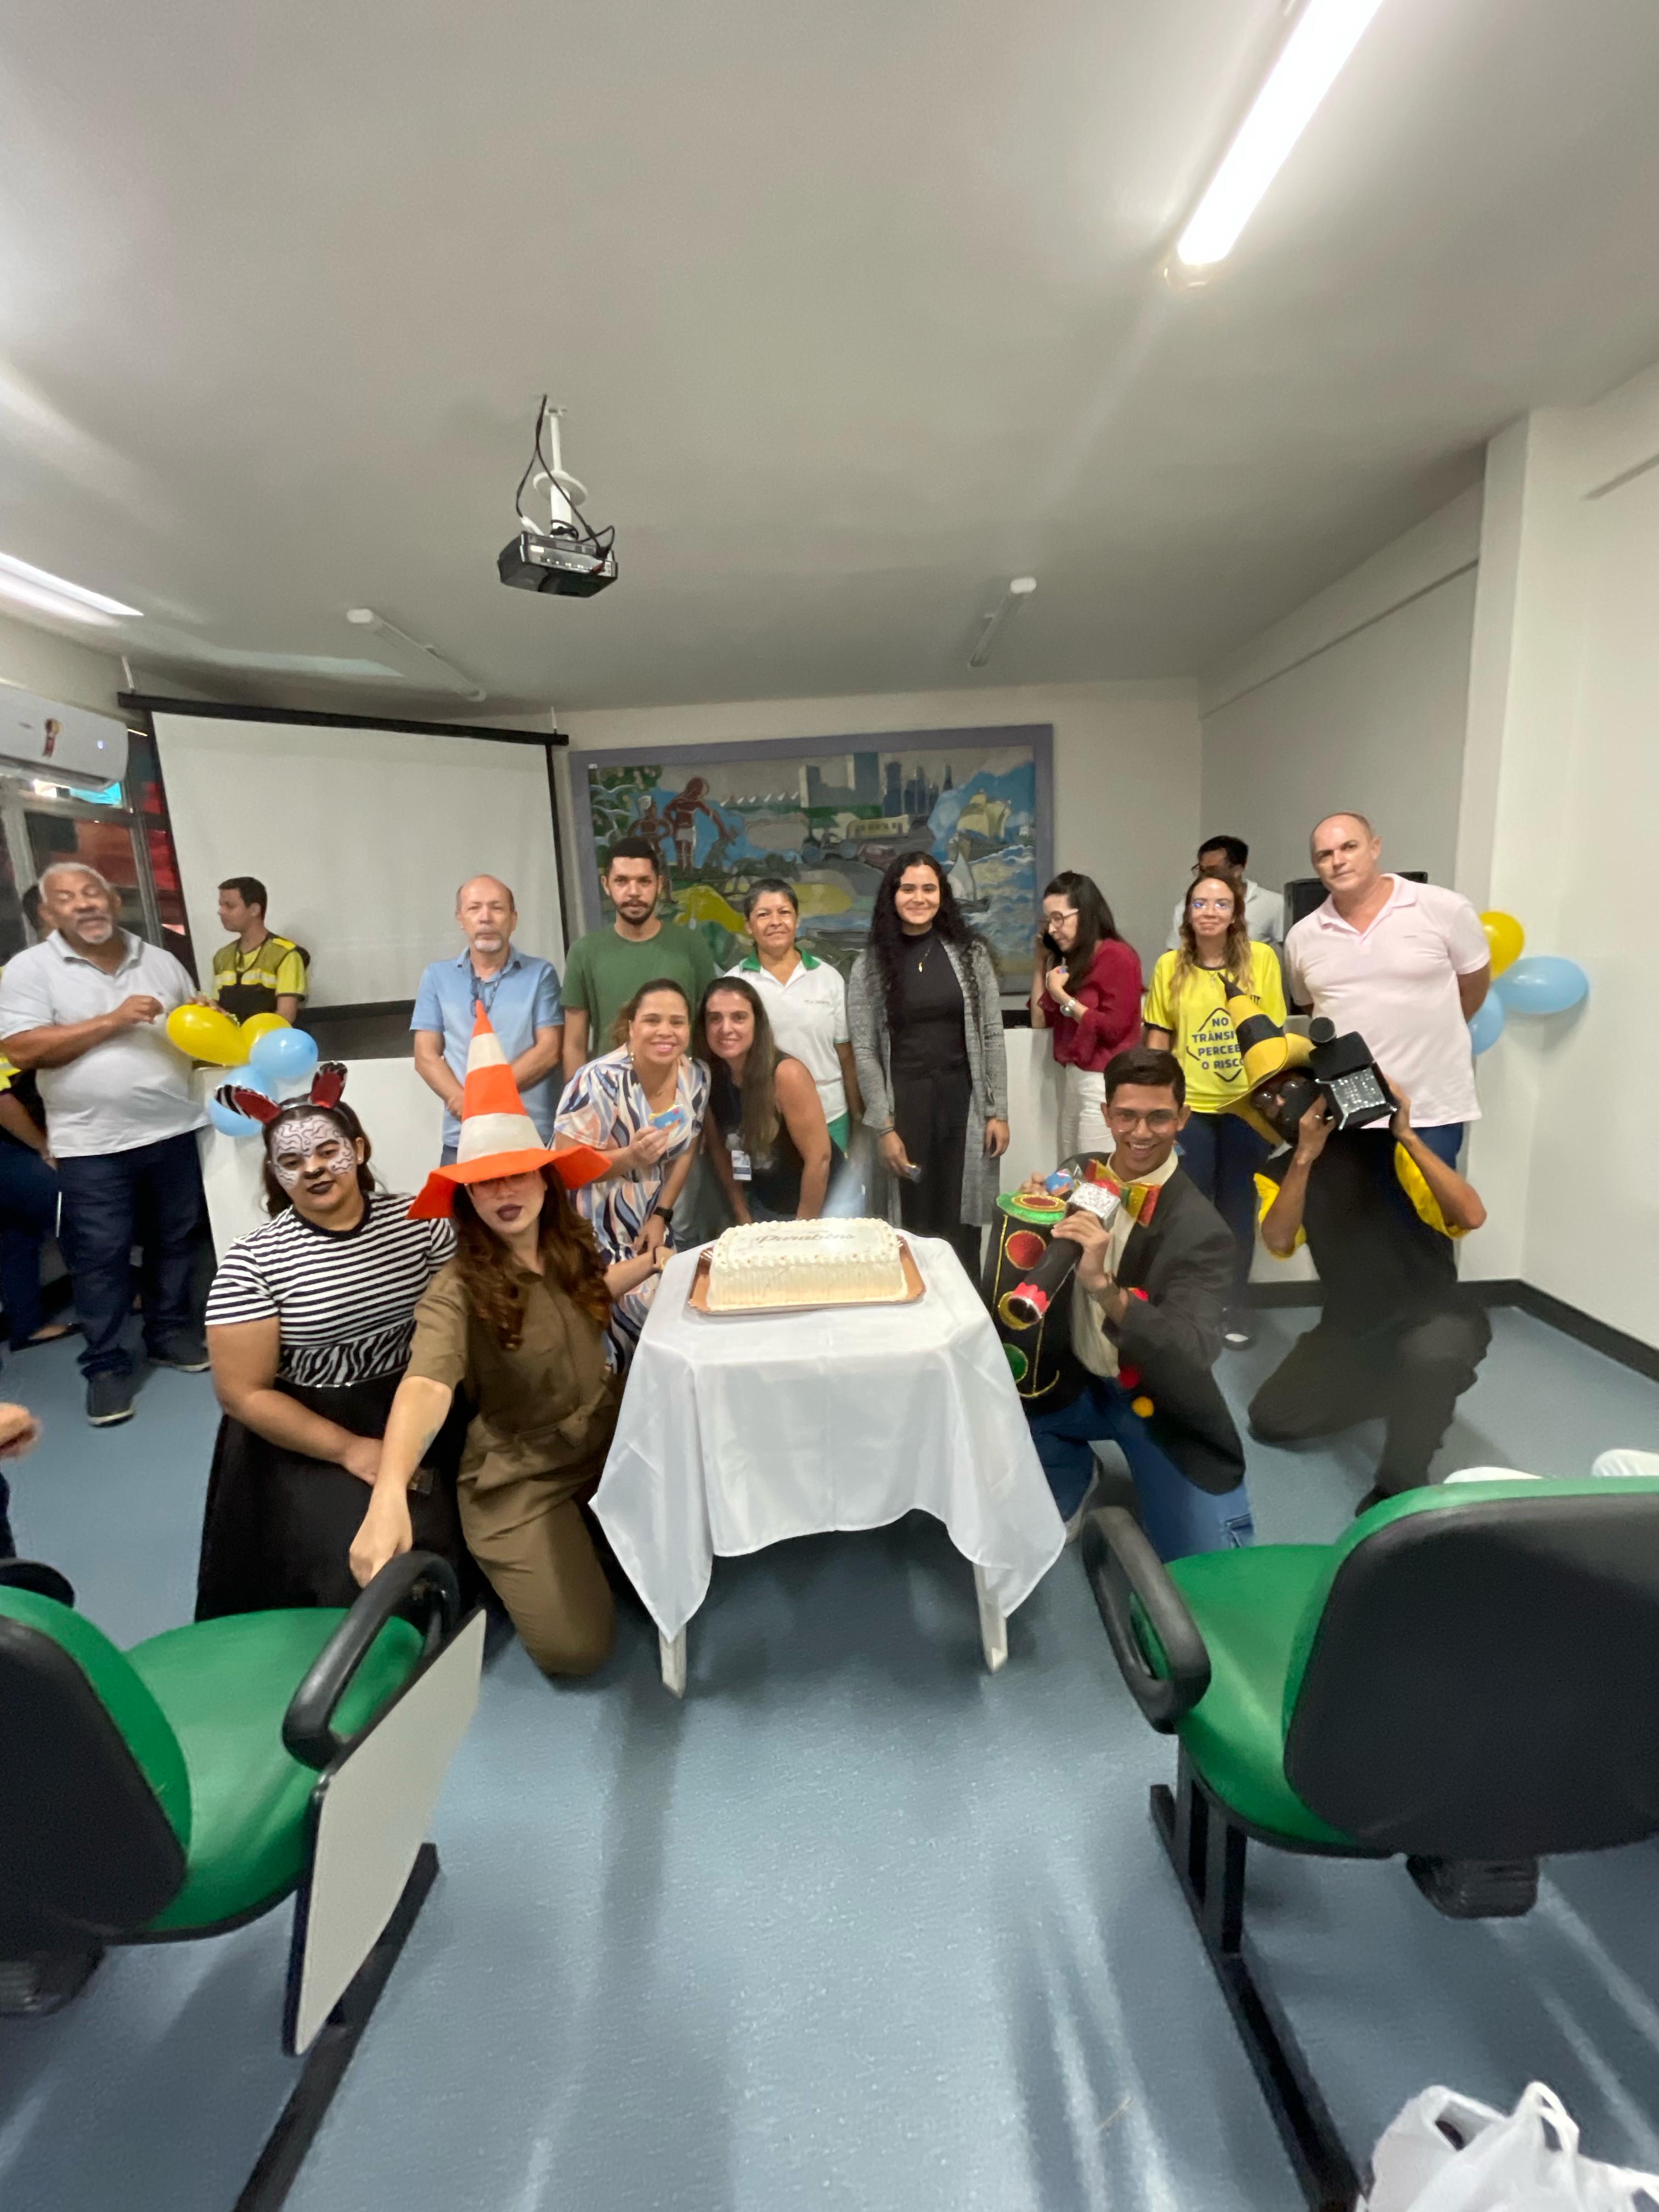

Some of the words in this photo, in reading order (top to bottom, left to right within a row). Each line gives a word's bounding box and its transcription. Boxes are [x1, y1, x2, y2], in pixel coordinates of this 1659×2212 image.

[1212, 1017, 1229, 1027] NO
[1192, 1030, 1234, 1043] TRÂNSI
[1198, 1044, 1240, 1057] PERCEB
[1201, 1061, 1209, 1070] O
